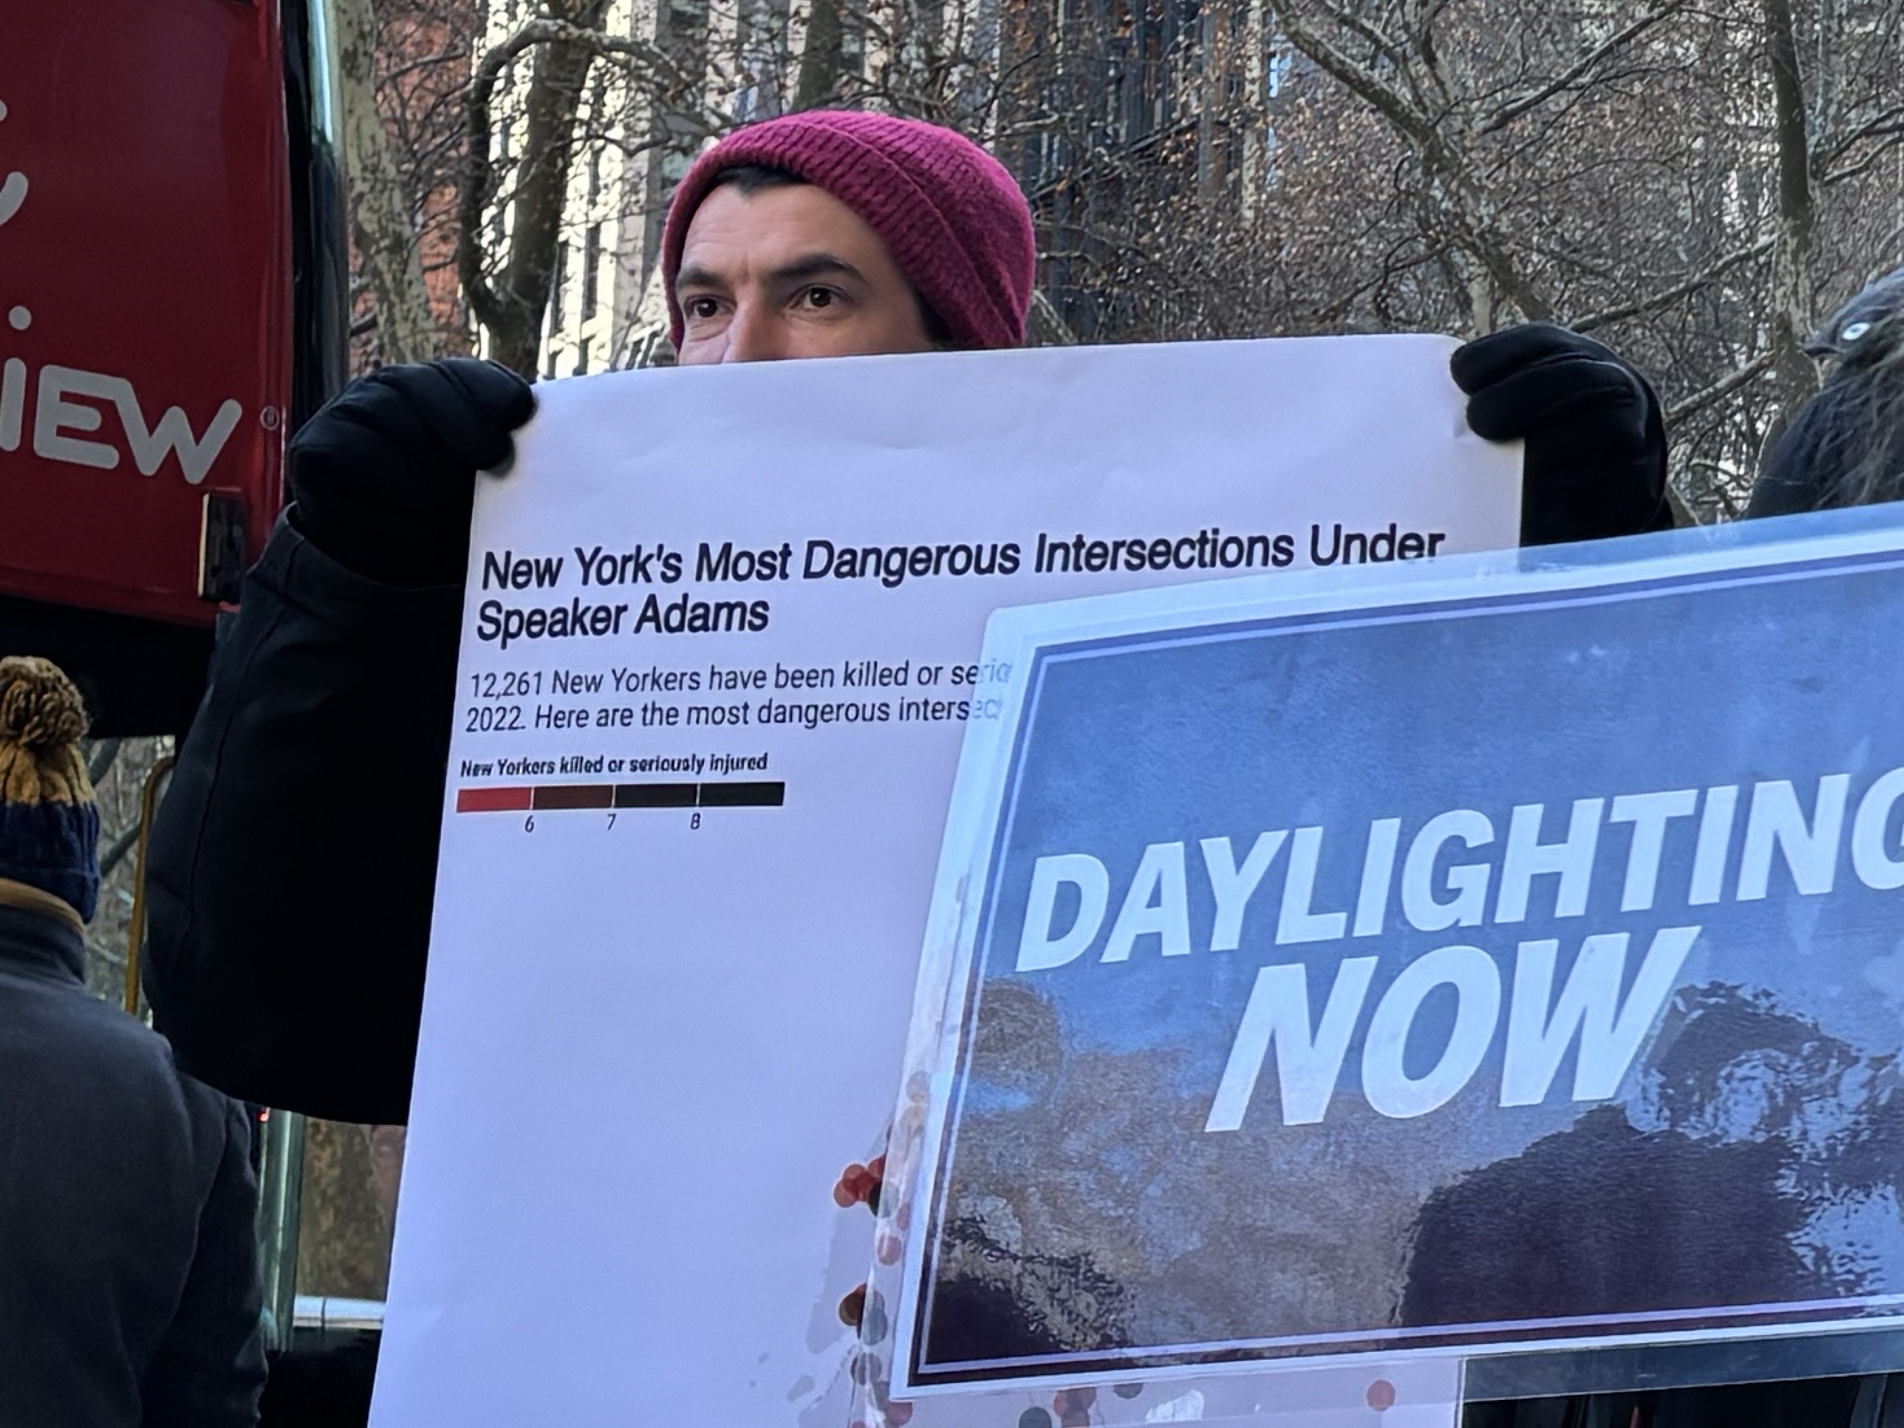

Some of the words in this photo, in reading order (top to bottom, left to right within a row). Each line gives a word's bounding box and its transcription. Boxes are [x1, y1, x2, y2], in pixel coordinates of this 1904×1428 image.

[482, 550, 563, 591] New
[574, 543, 683, 586] York's
[694, 541, 792, 583] Most
[803, 539, 1020, 587] Dangerous
[1034, 529, 1295, 573] Intersections
[1309, 523, 1446, 566] Under
[476, 597, 628, 649] Speaker
[634, 593, 770, 634] Adams
[470, 671, 543, 701] 12,261
[551, 669, 604, 694] New
[612, 666, 701, 694] Yorkers
[708, 663, 767, 691] have
[774, 661, 835, 689] been
[842, 659, 909, 688] killed
[916, 664, 943, 687] or
[465, 704, 526, 732] 2022.
[534, 703, 590, 729] Here
[595, 706, 634, 728] are
[640, 700, 680, 726] the
[686, 699, 750, 726] most
[757, 697, 890, 729] dangerous
[460, 759, 493, 777] New
[497, 757, 555, 776] Yorkers
[559, 755, 604, 774] killed
[607, 758, 625, 773] or
[629, 754, 706, 776] seriously
[709, 752, 768, 774] injured
[524, 815, 535, 833] 6
[606, 813, 617, 831] 7
[689, 811, 700, 830] 8
[1204, 924, 1702, 1134] NOW
